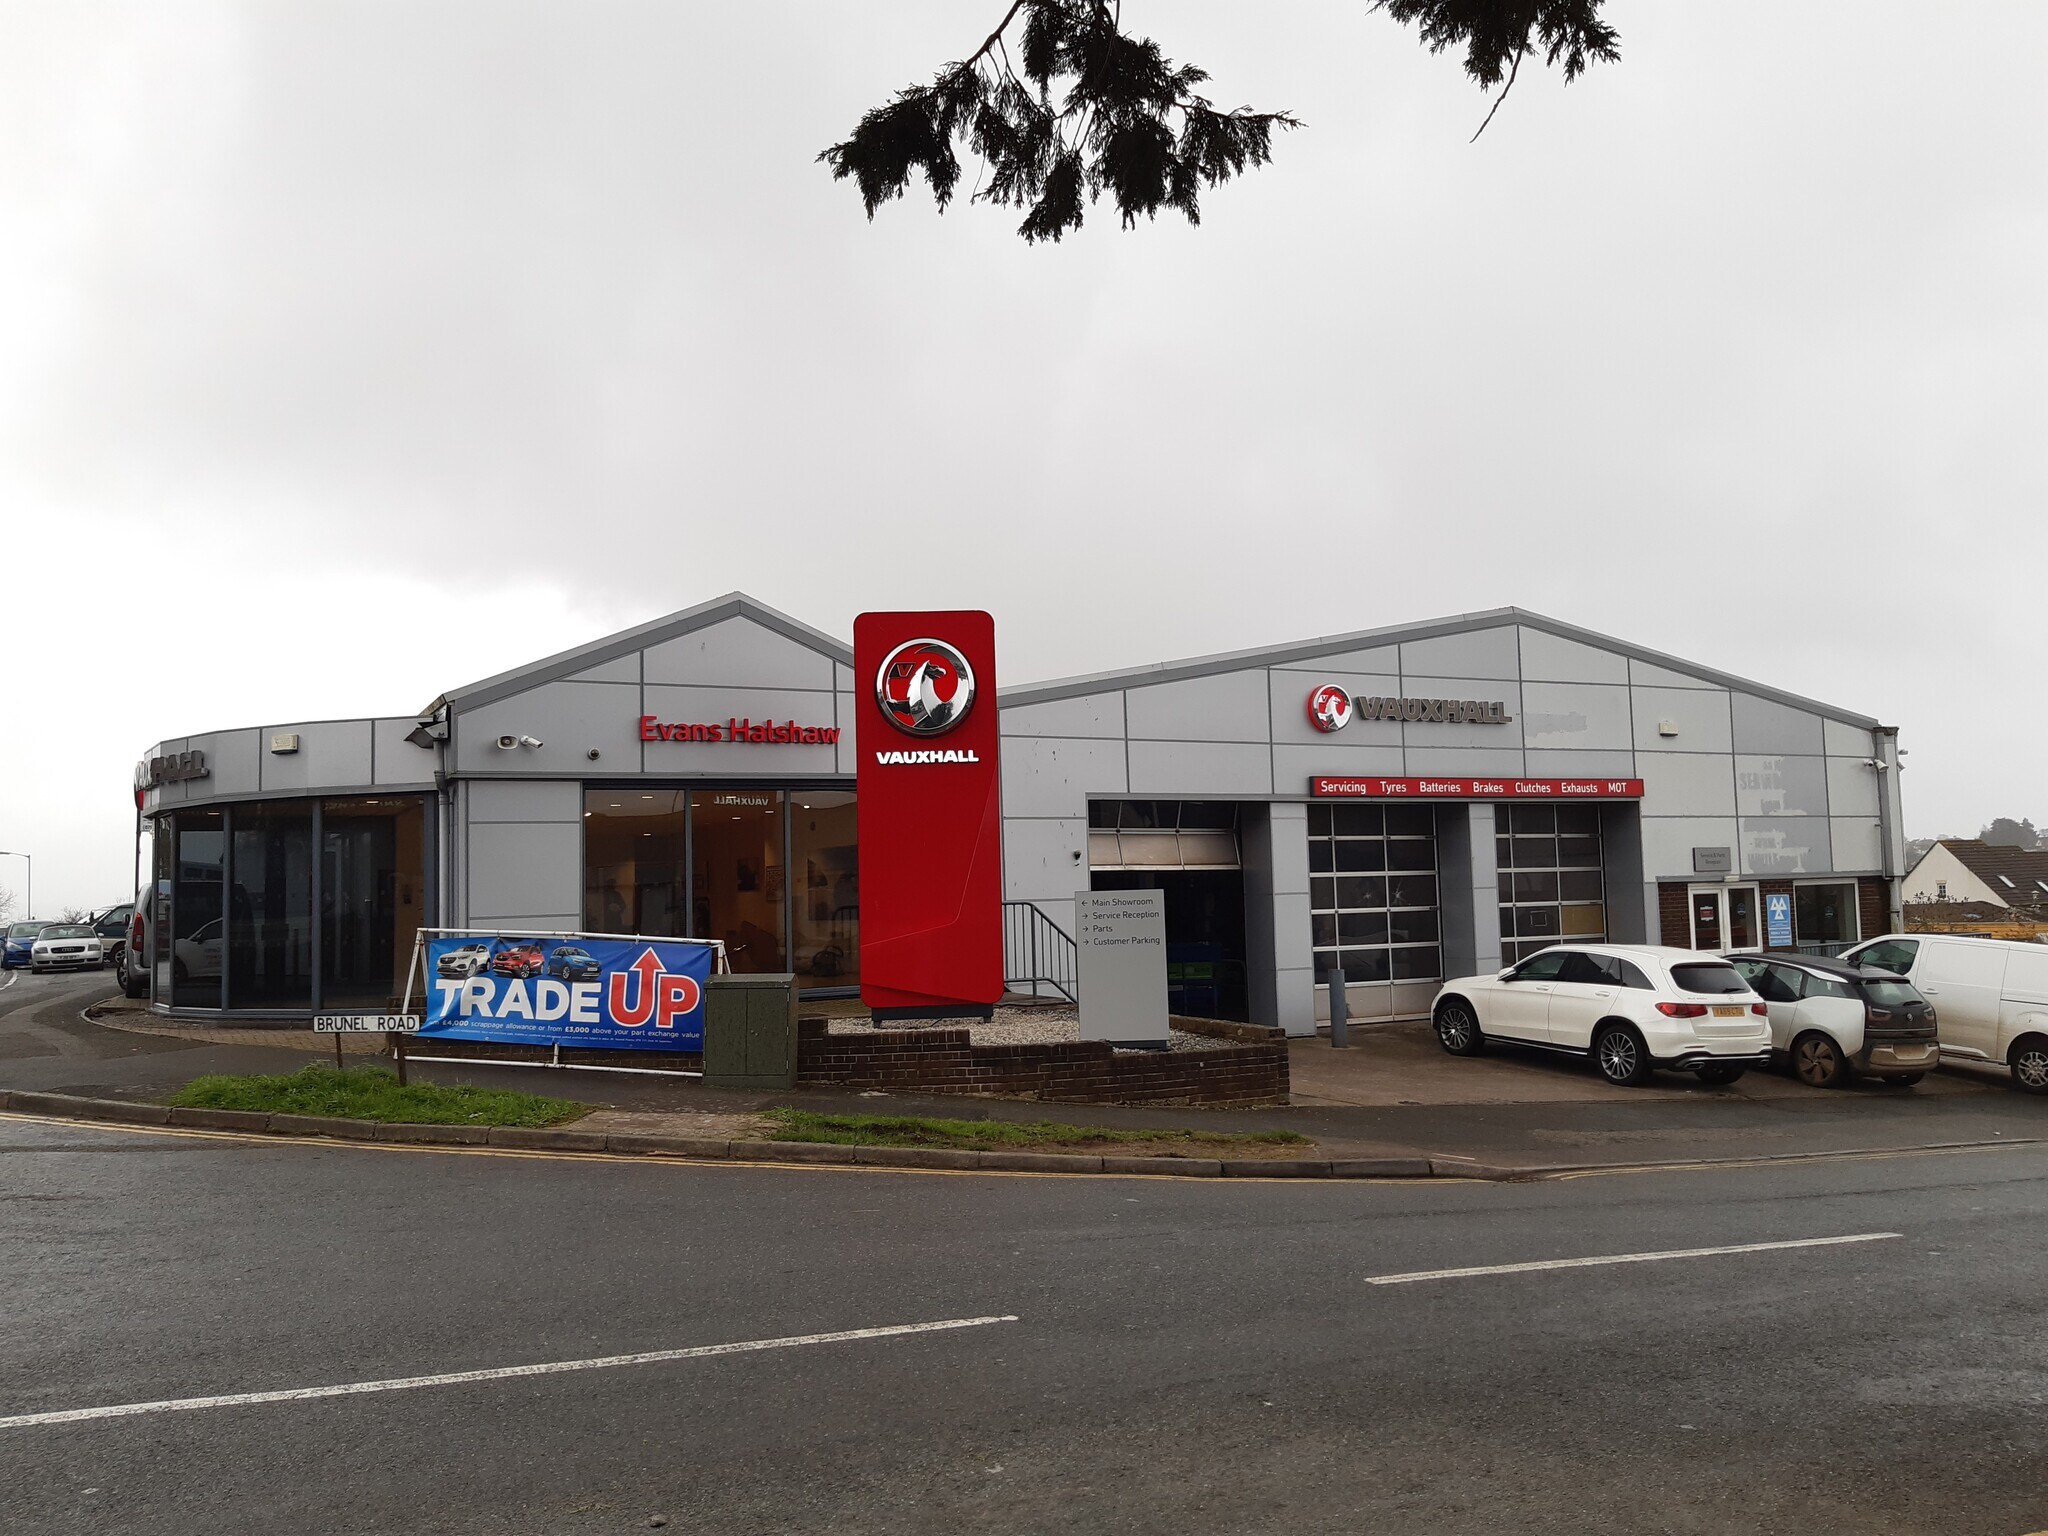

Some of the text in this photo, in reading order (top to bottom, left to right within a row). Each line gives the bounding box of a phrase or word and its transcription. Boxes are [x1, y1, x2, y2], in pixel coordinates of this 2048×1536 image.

[1357, 696, 1513, 724] VAUXHALL
[640, 715, 841, 744] Evans Halshaw
[876, 750, 979, 764] VAUXHALL
[1321, 780, 1627, 795] Servicing Tyres Batteries Brakes Clutches Exhausts MOT
[1091, 898, 1154, 907] Main Showroom
[1122, 911, 1160, 919] Reception
[1092, 924, 1113, 932] Parts
[1093, 936, 1161, 946] Customer Parking
[435, 947, 701, 1029] TRADE UP
[317, 1017, 368, 1031] BRUNEL
[378, 1016, 416, 1030] ROAD
[471, 1021, 504, 1029] scrappage
[505, 1023, 536, 1031] allowance
[564, 1026, 590, 1034] £3,000
[614, 1029, 629, 1037] your
[631, 1029, 646, 1037] part
[647, 1030, 680, 1038] exchange
[681, 1031, 700, 1039] value
